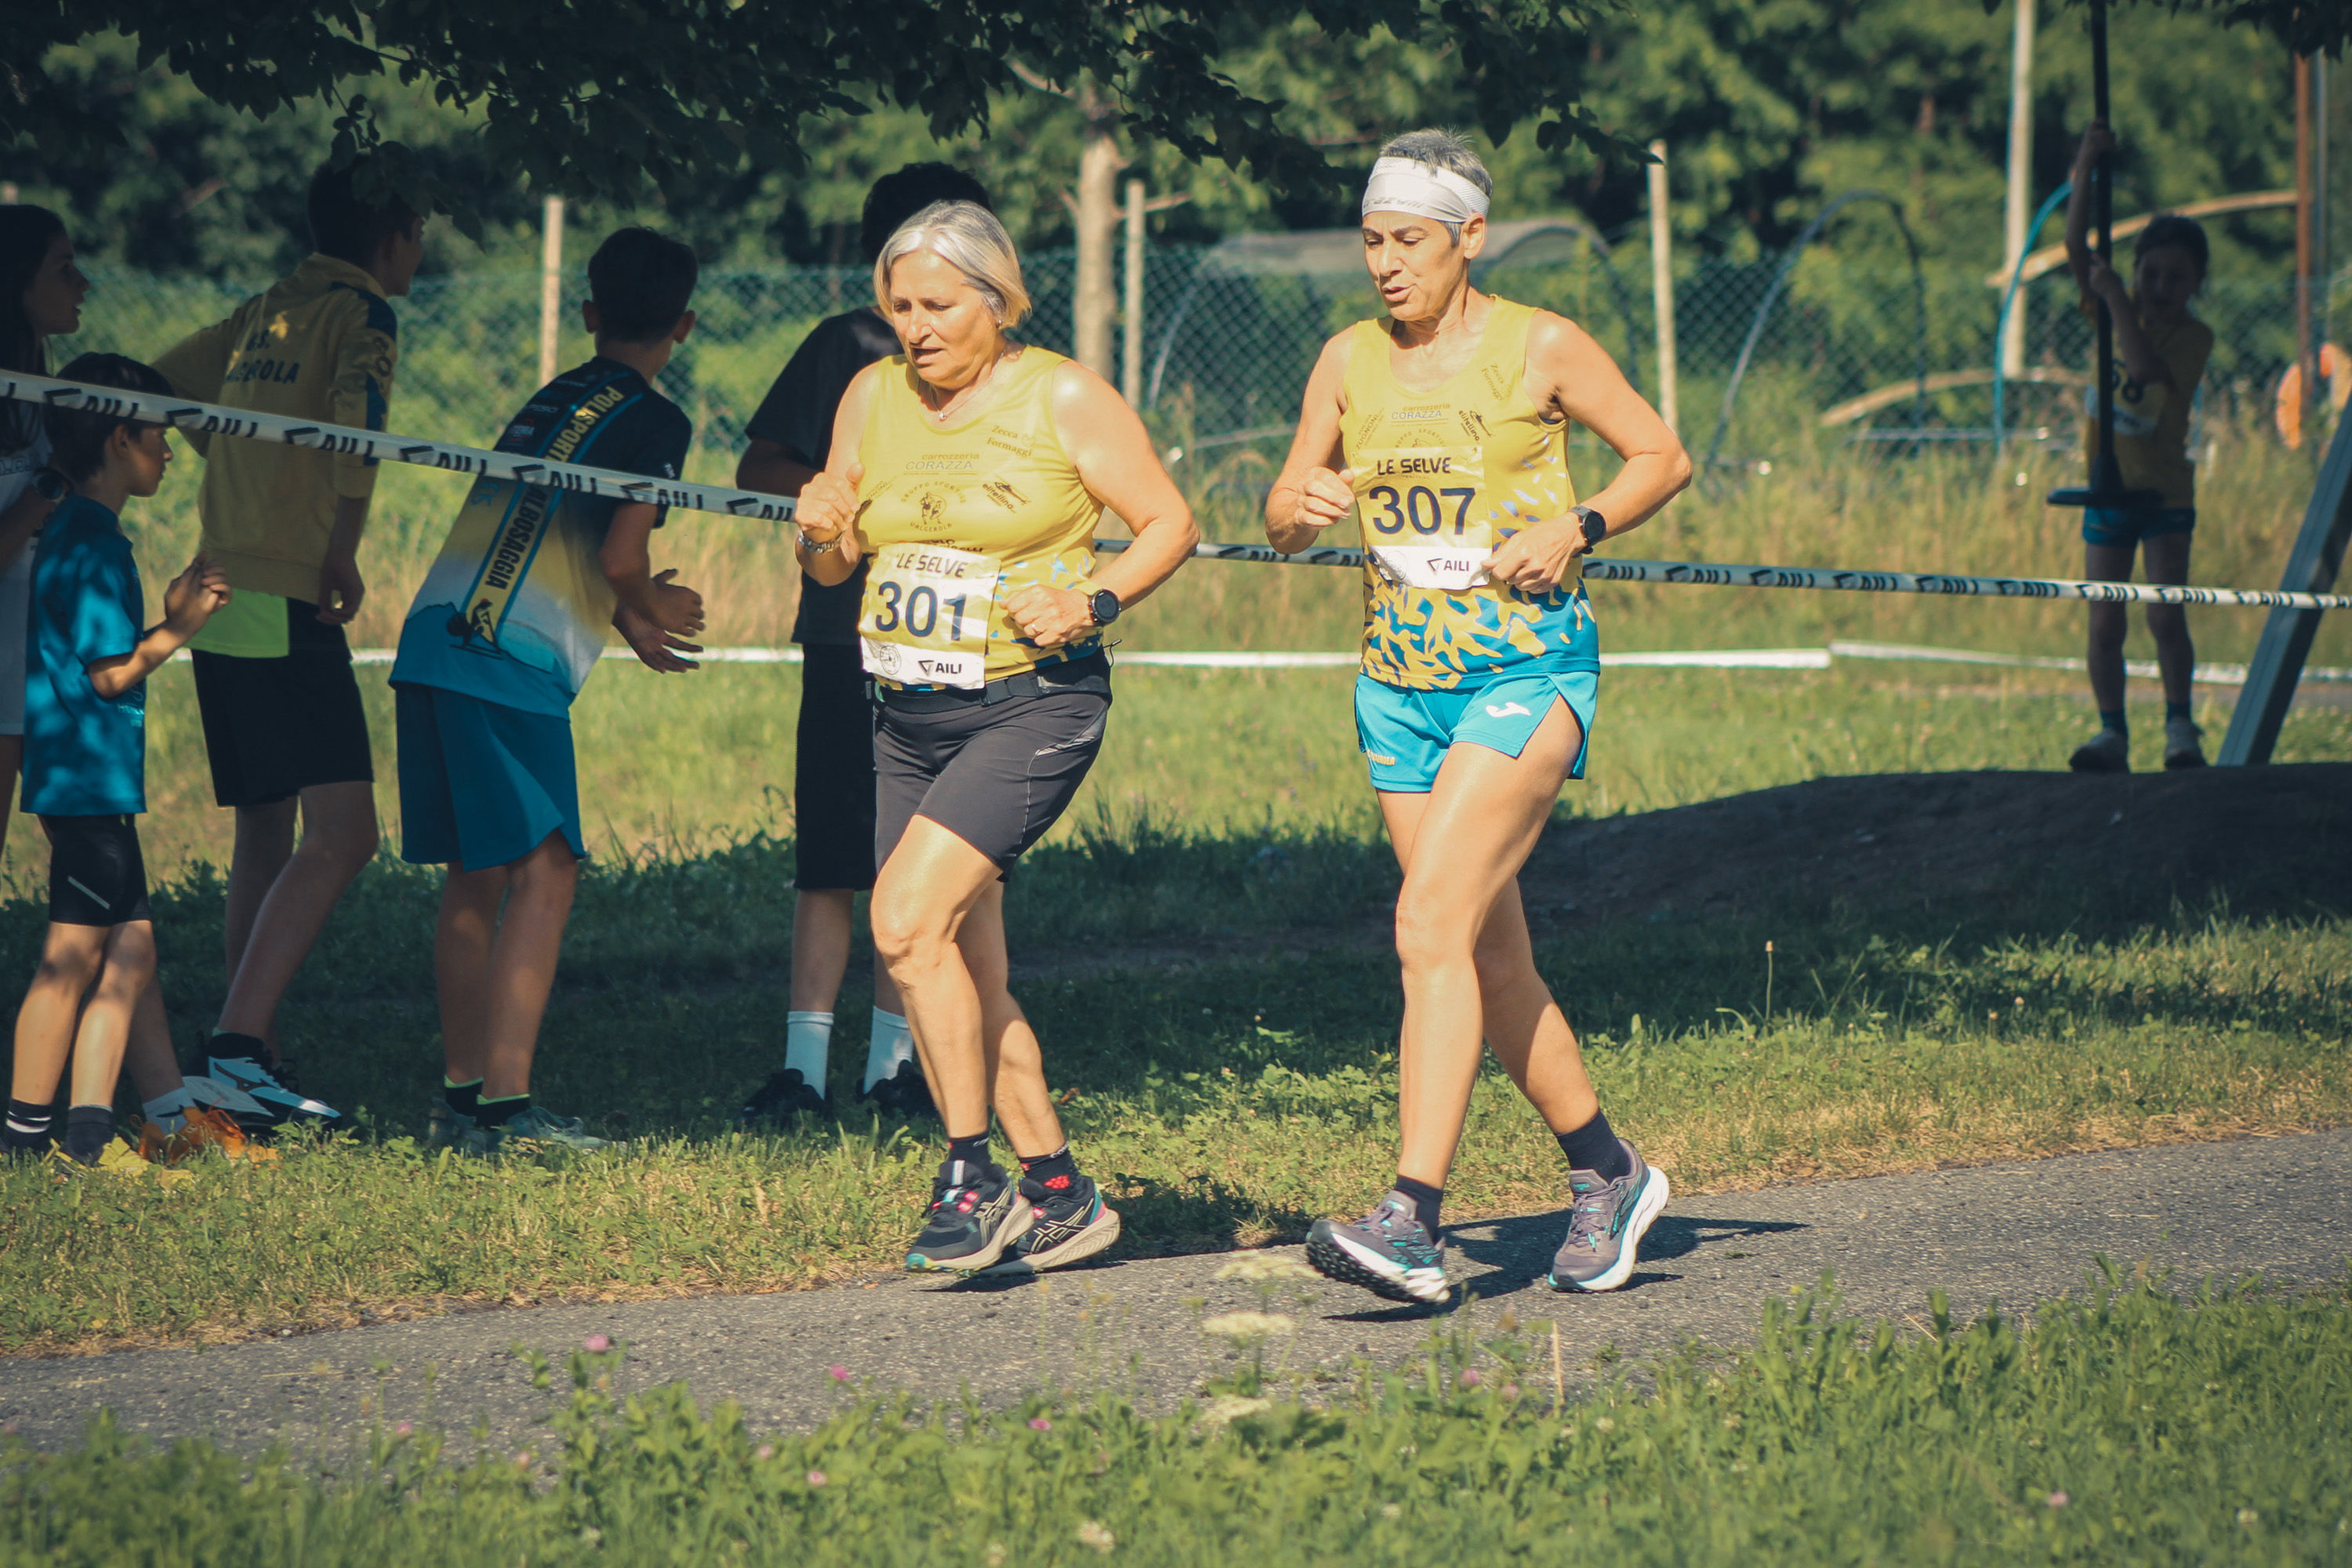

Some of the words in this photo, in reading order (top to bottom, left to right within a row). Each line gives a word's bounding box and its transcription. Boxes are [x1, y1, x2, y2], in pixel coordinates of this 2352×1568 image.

[1392, 411, 1442, 420] CORAZZA
[992, 425, 1018, 439] Zecca
[986, 437, 1033, 458] Formaggi
[906, 461, 973, 470] CORAZZA
[1377, 459, 1396, 475] LE
[1400, 457, 1452, 474] SELVE
[1369, 485, 1475, 535] 307
[485, 485, 548, 590] ALBOSAGGIA
[897, 553, 916, 568] LE
[916, 555, 969, 579] SELVE
[1443, 560, 1469, 572] AILI
[876, 581, 967, 641] 301
[935, 662, 962, 674] AILI
